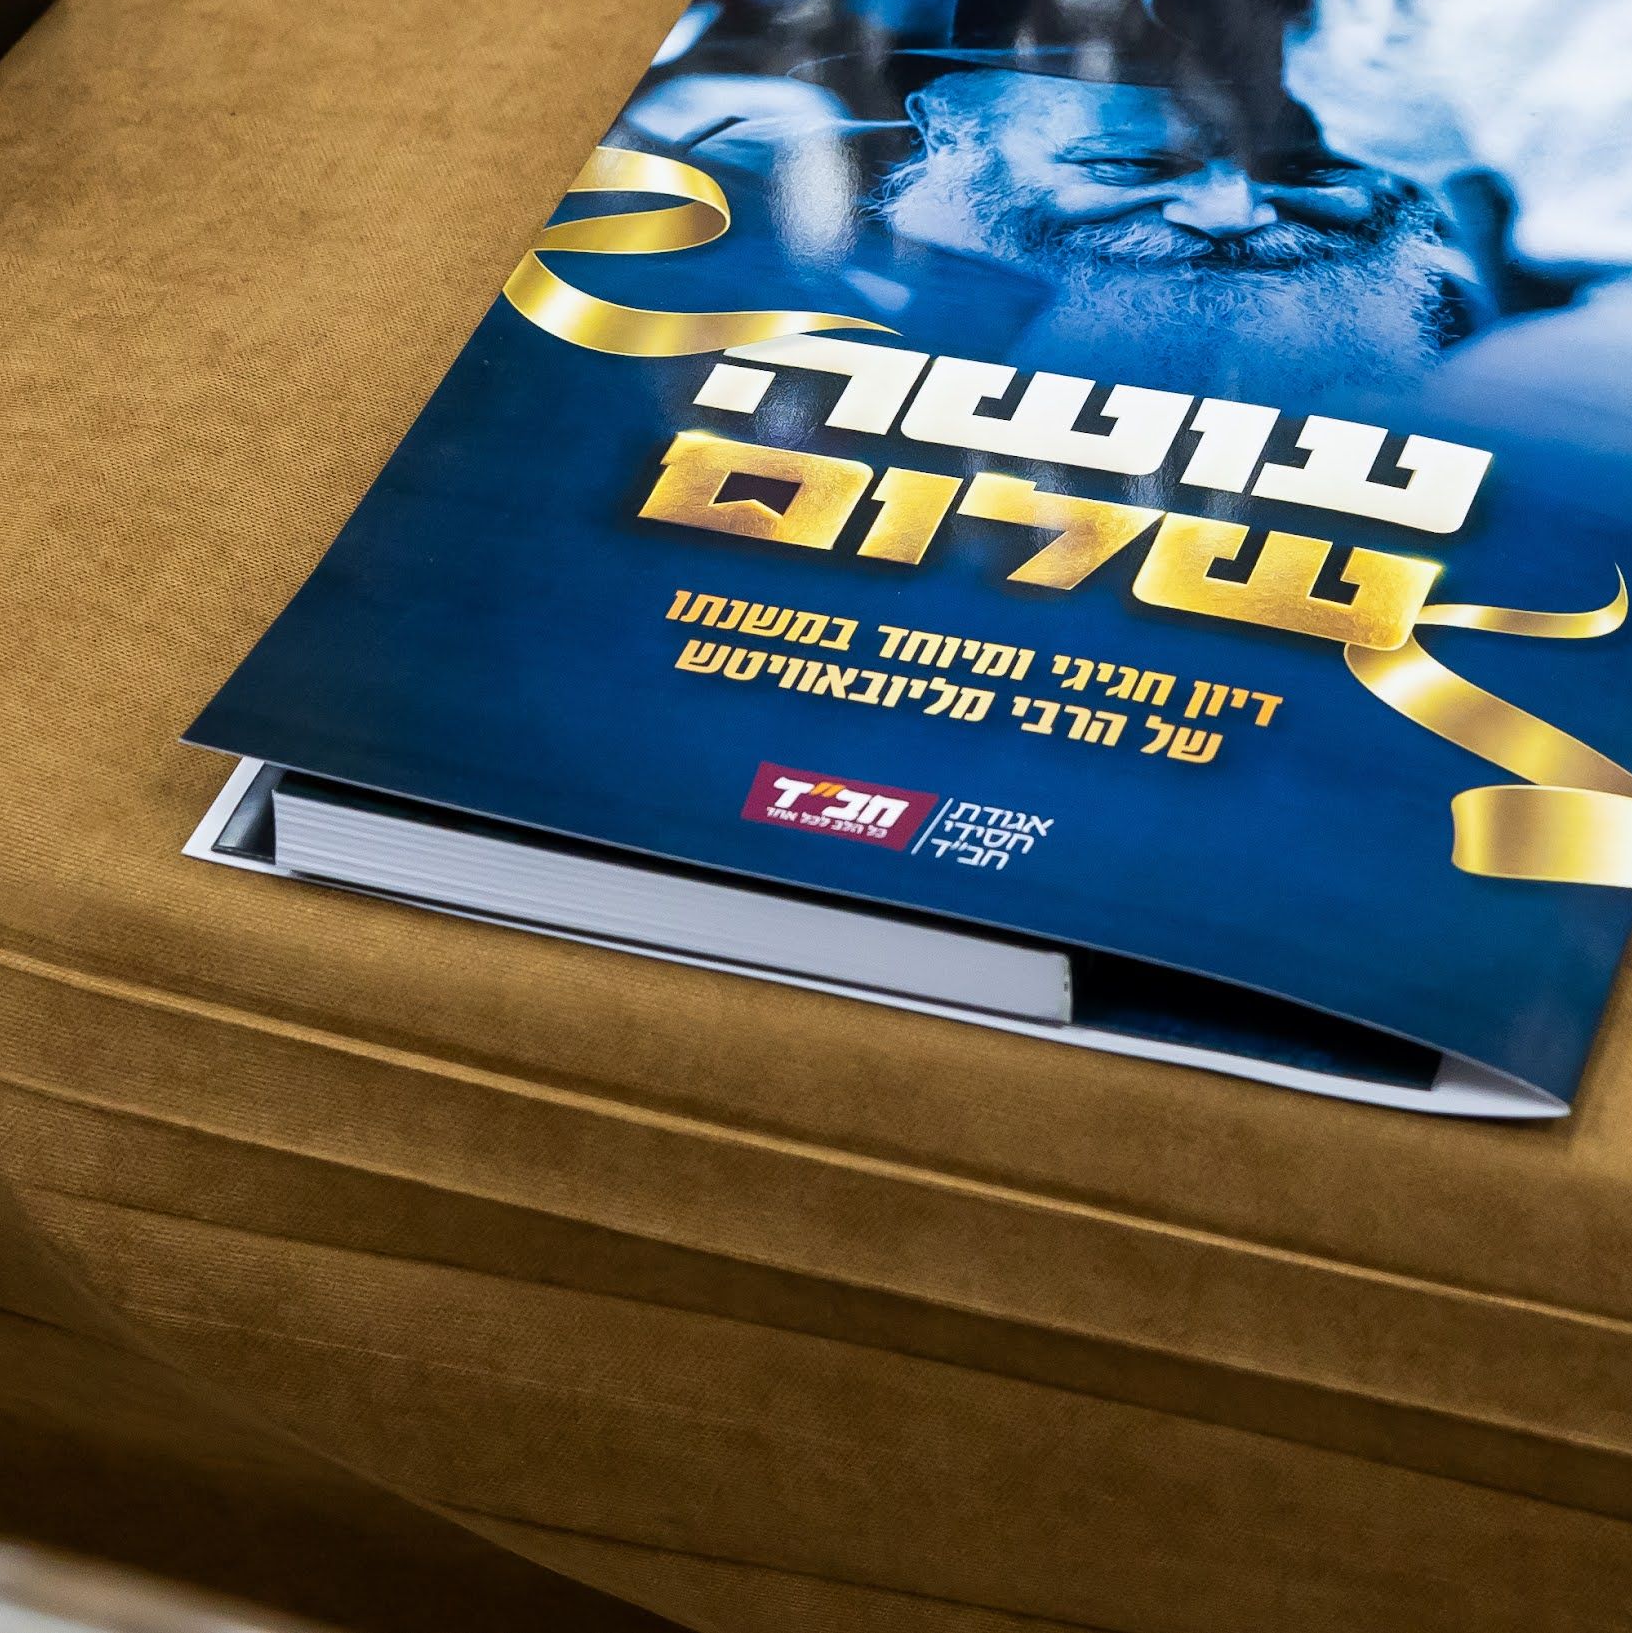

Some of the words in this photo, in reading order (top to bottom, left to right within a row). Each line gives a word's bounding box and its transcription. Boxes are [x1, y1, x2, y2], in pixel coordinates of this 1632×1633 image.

[692, 335, 1493, 534] עושה
[637, 429, 1444, 653] שלום
[666, 589, 860, 652] במשנתו
[876, 623, 1036, 682] ומיוחד
[674, 639, 996, 724] מליובאוויטש
[1051, 654, 1177, 707] חגיגי
[1183, 679, 1284, 728] דיון
[1011, 692, 1128, 747] הרבי
[1140, 715, 1224, 765] של
[773, 776, 910, 828] חב"ד
[948, 801, 1055, 838] אגודת
[930, 837, 1010, 871] חב"ד
[943, 819, 1035, 855] חסידי
